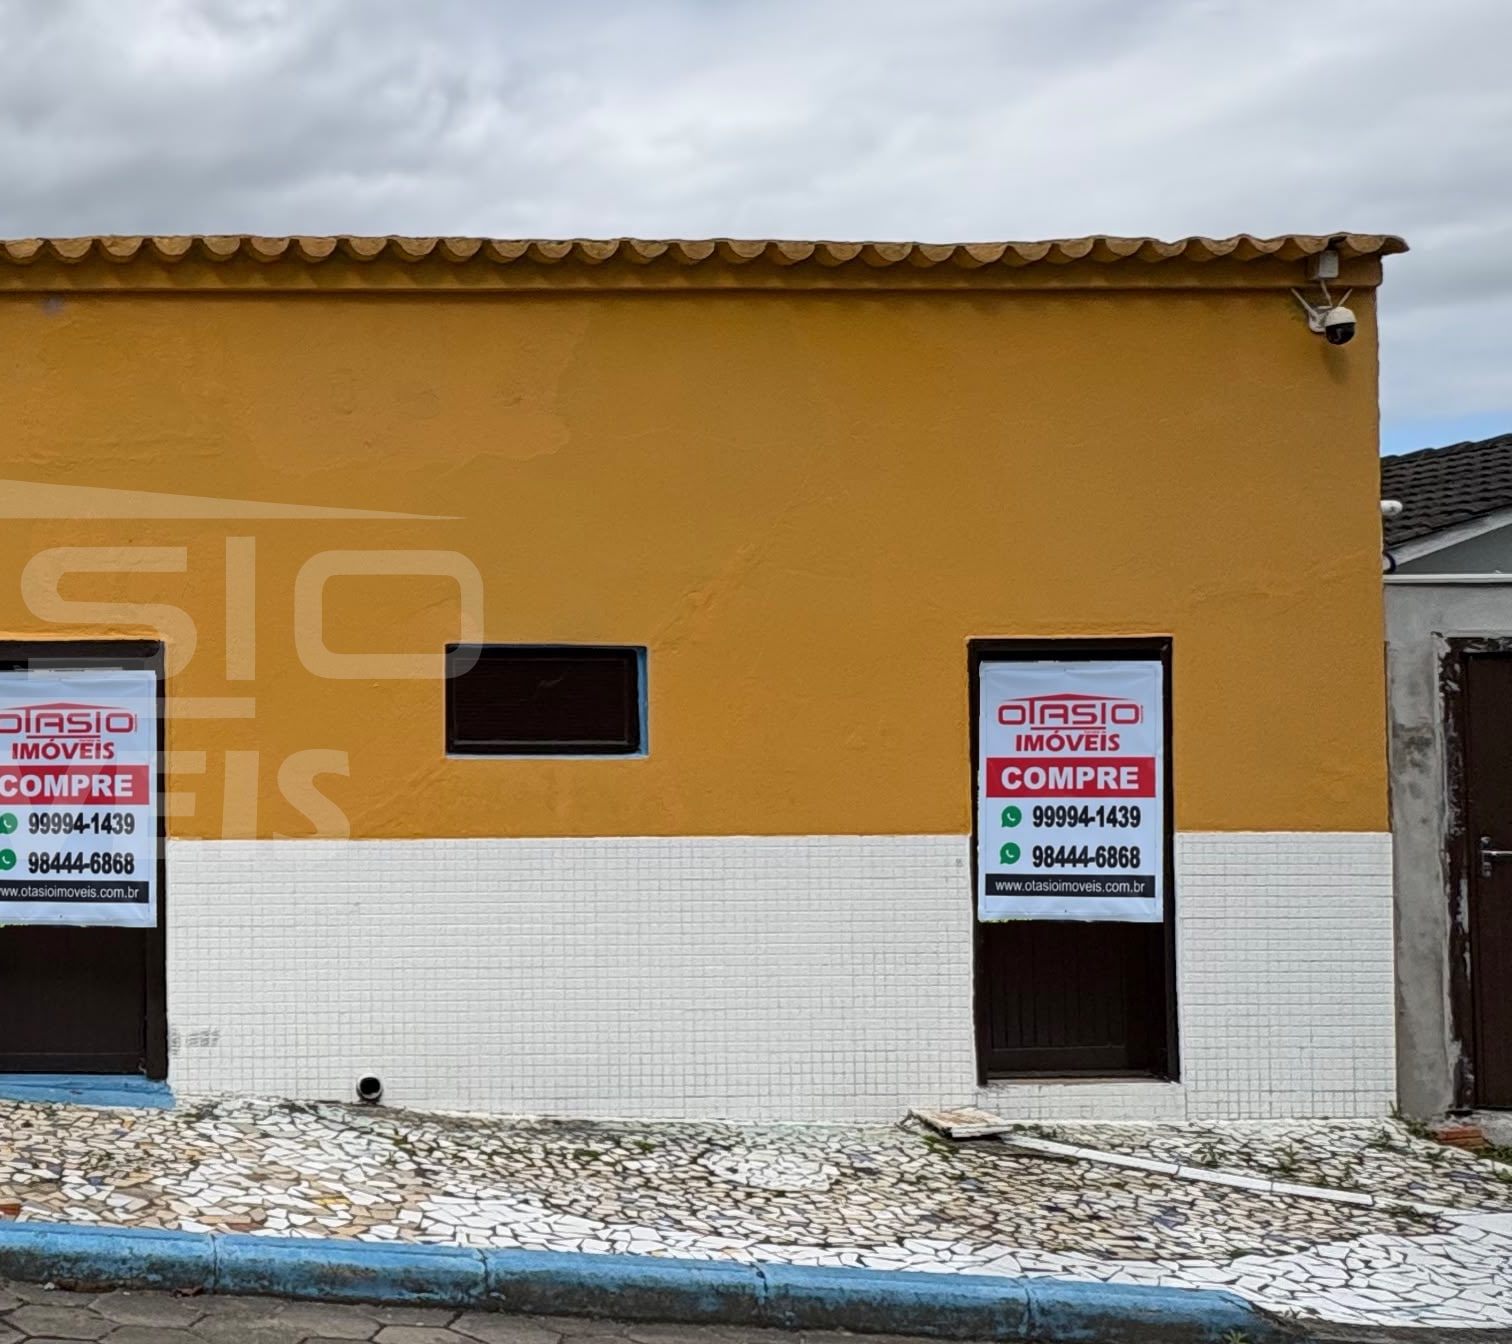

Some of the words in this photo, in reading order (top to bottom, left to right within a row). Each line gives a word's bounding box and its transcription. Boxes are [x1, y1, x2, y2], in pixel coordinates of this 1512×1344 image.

[997, 699, 1140, 725] OTASIO
[11, 738, 115, 761] IMÓVEIS
[1015, 731, 1121, 752] IMÓVEIS
[1000, 766, 1140, 790] COMPRE
[28, 812, 135, 835] 99994-1439
[1032, 805, 1142, 828] 99994-1439
[27, 852, 135, 875] 98444-6868
[1031, 845, 1141, 868] 98444-6868
[995, 880, 1146, 895] www.otasioimoveis.com.br
